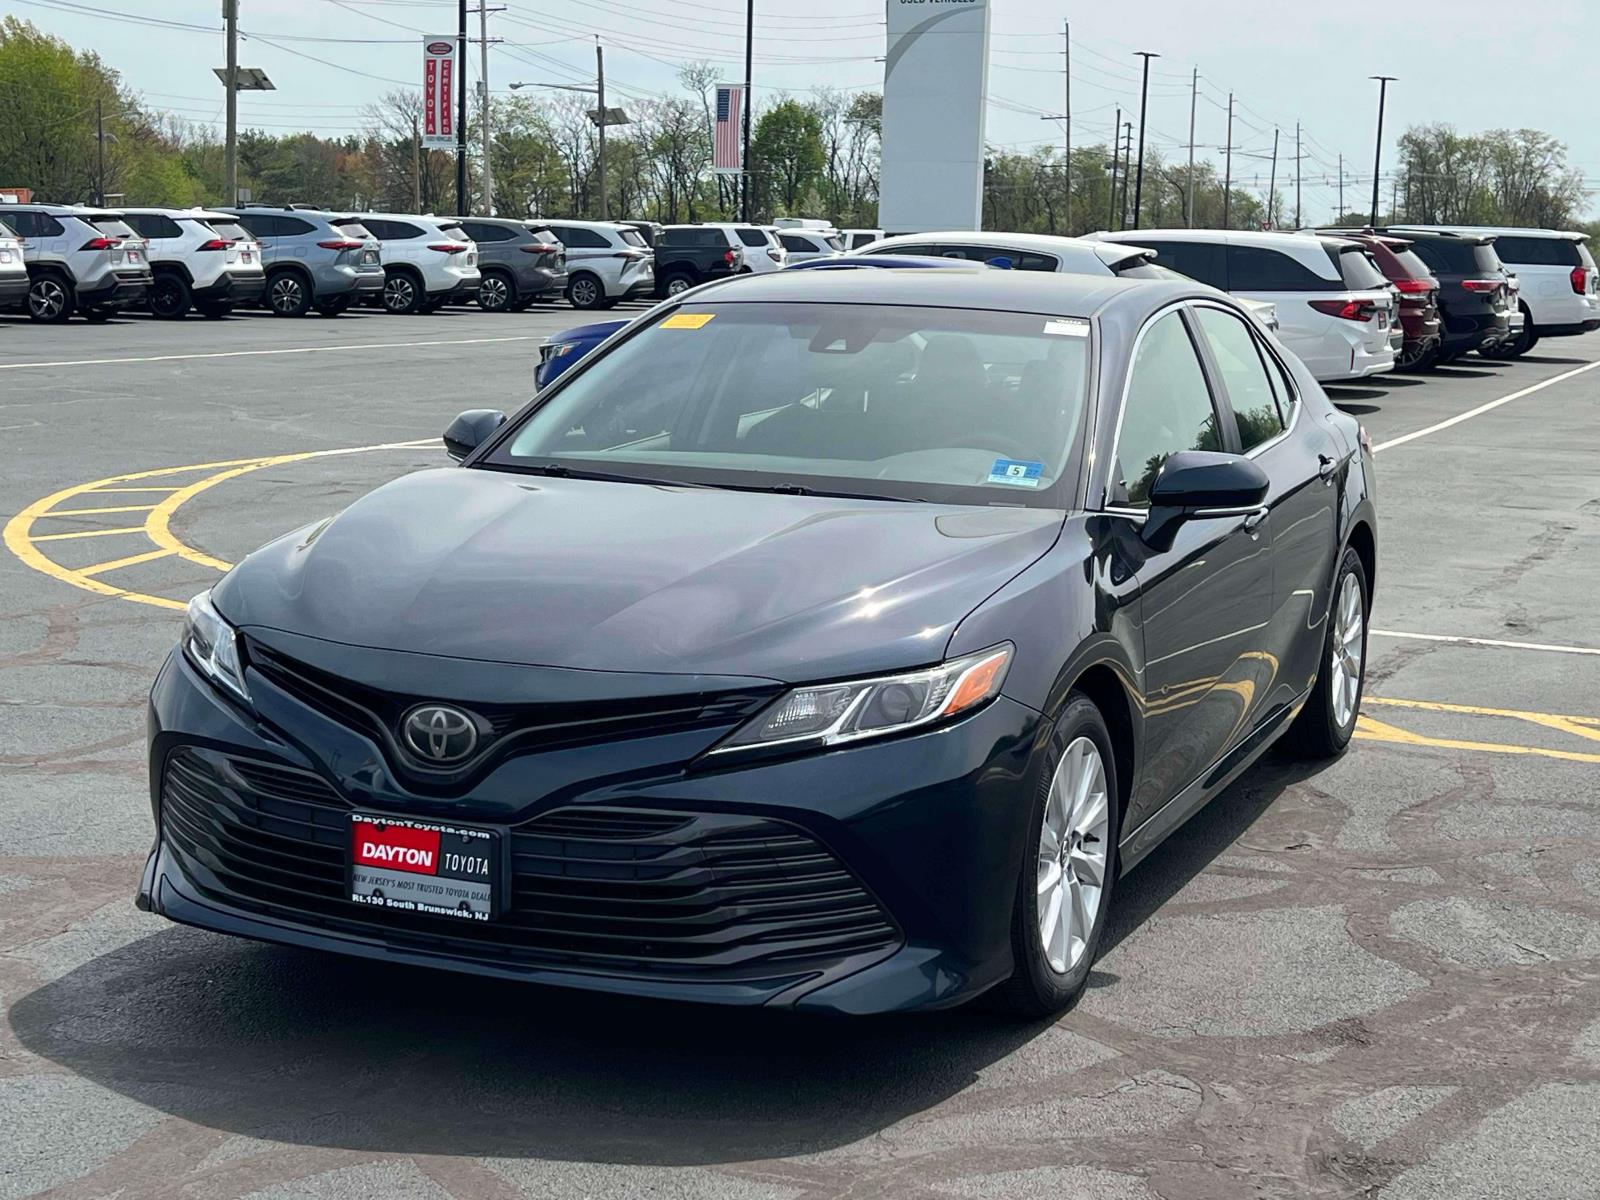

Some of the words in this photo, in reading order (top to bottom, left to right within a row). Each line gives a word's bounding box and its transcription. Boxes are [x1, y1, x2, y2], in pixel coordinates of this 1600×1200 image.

[1012, 467, 1020, 475] 5
[352, 814, 490, 839] DaytonToyota.com
[362, 842, 433, 867] DAYTON
[445, 853, 489, 875] TOYOTA
[352, 873, 368, 882] NEW
[368, 876, 396, 888] JERSEY'S
[397, 880, 415, 890] MOST
[416, 883, 444, 895] TRUSTED
[445, 887, 470, 899] TOYOTA
[386, 898, 415, 910] South
[474, 911, 489, 921] NJ
